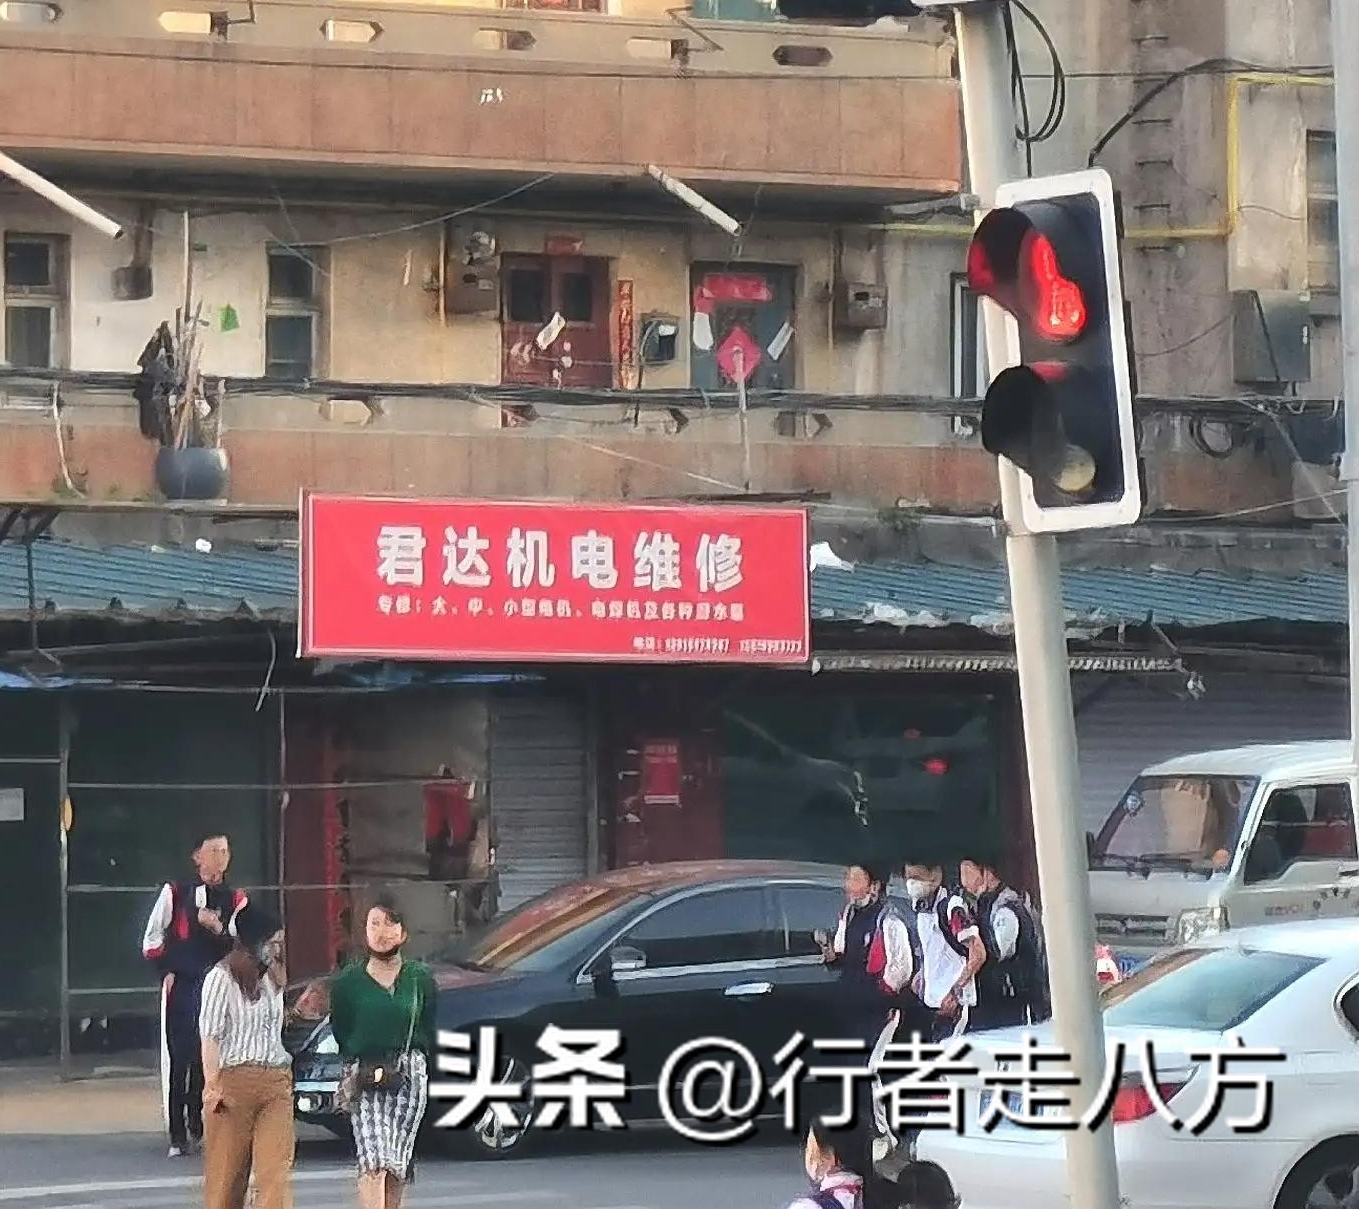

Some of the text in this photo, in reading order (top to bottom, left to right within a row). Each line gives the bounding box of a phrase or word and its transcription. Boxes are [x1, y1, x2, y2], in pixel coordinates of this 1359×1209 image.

[377, 526, 745, 592] 君达机电维修
